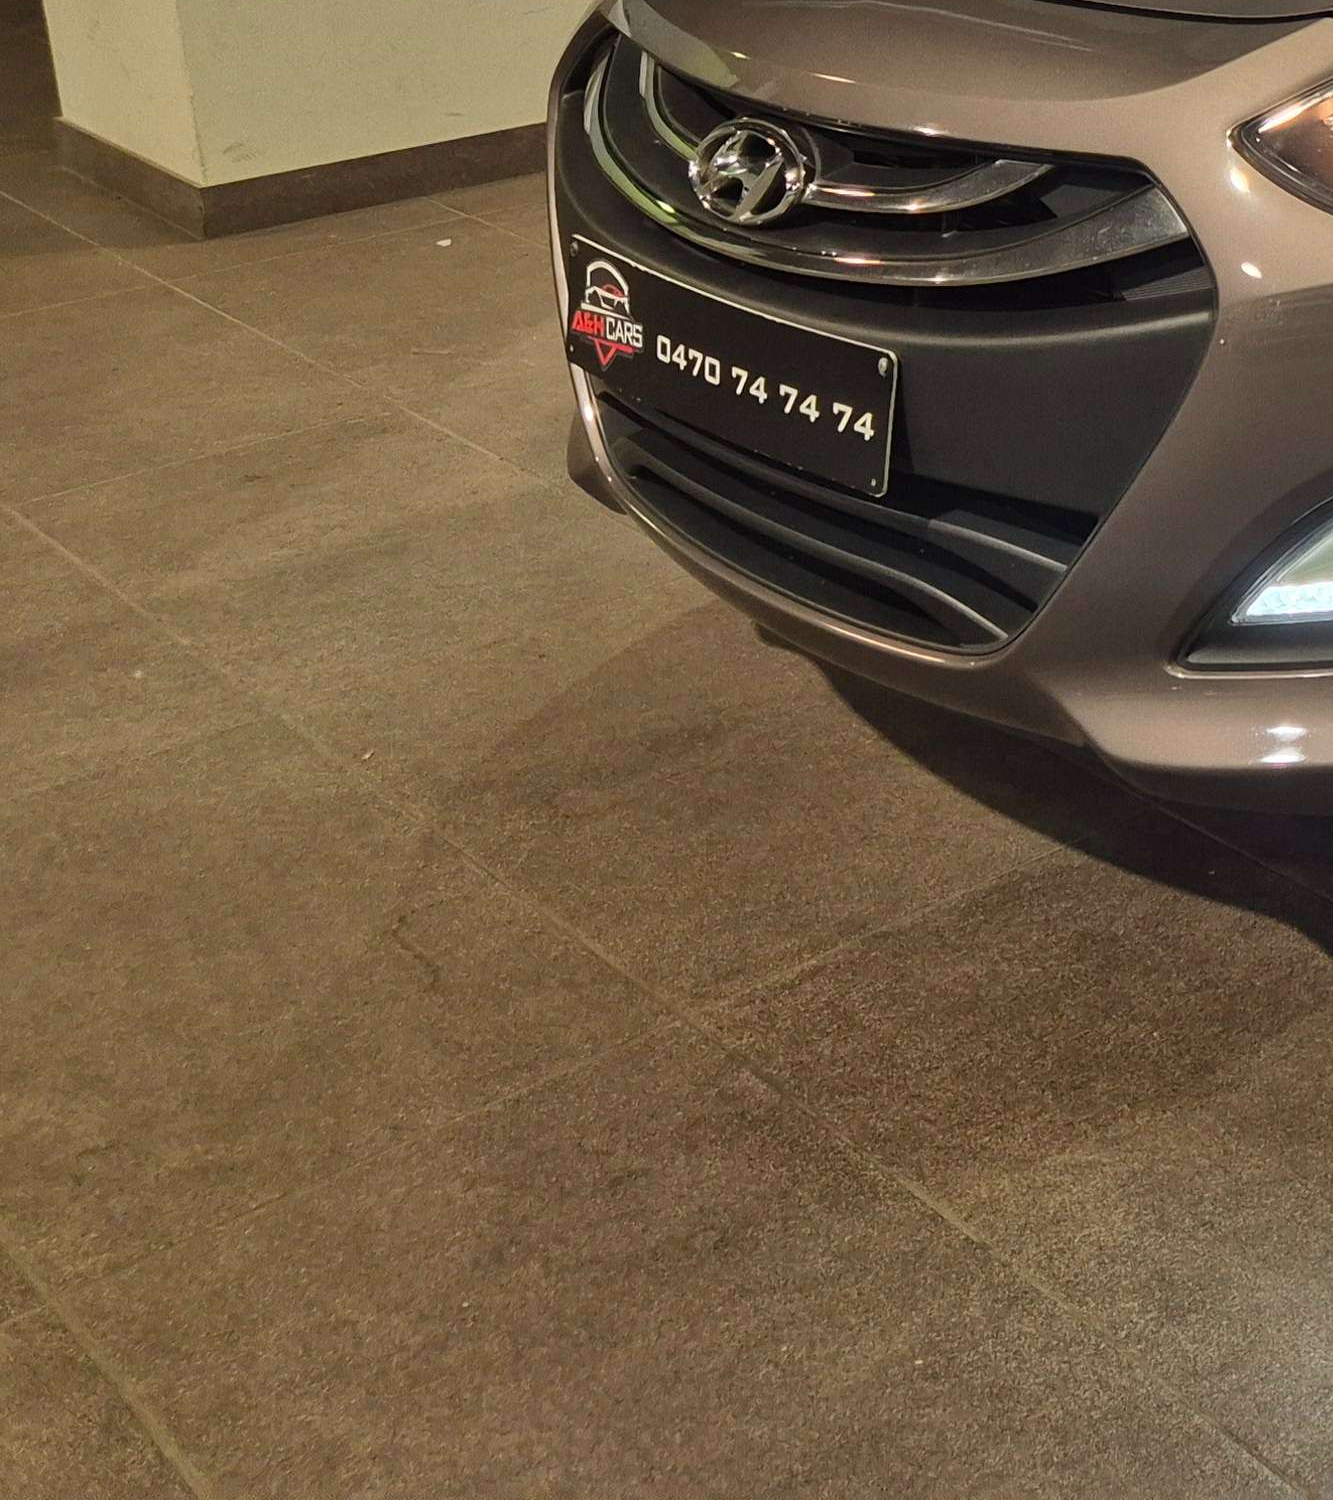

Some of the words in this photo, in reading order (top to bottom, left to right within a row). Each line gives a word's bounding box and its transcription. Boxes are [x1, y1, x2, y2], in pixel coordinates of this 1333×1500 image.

[606, 316, 643, 348] CARS
[656, 335, 721, 386] 0470
[731, 366, 768, 404] 74
[779, 384, 820, 423] 74
[832, 402, 875, 442] 74
